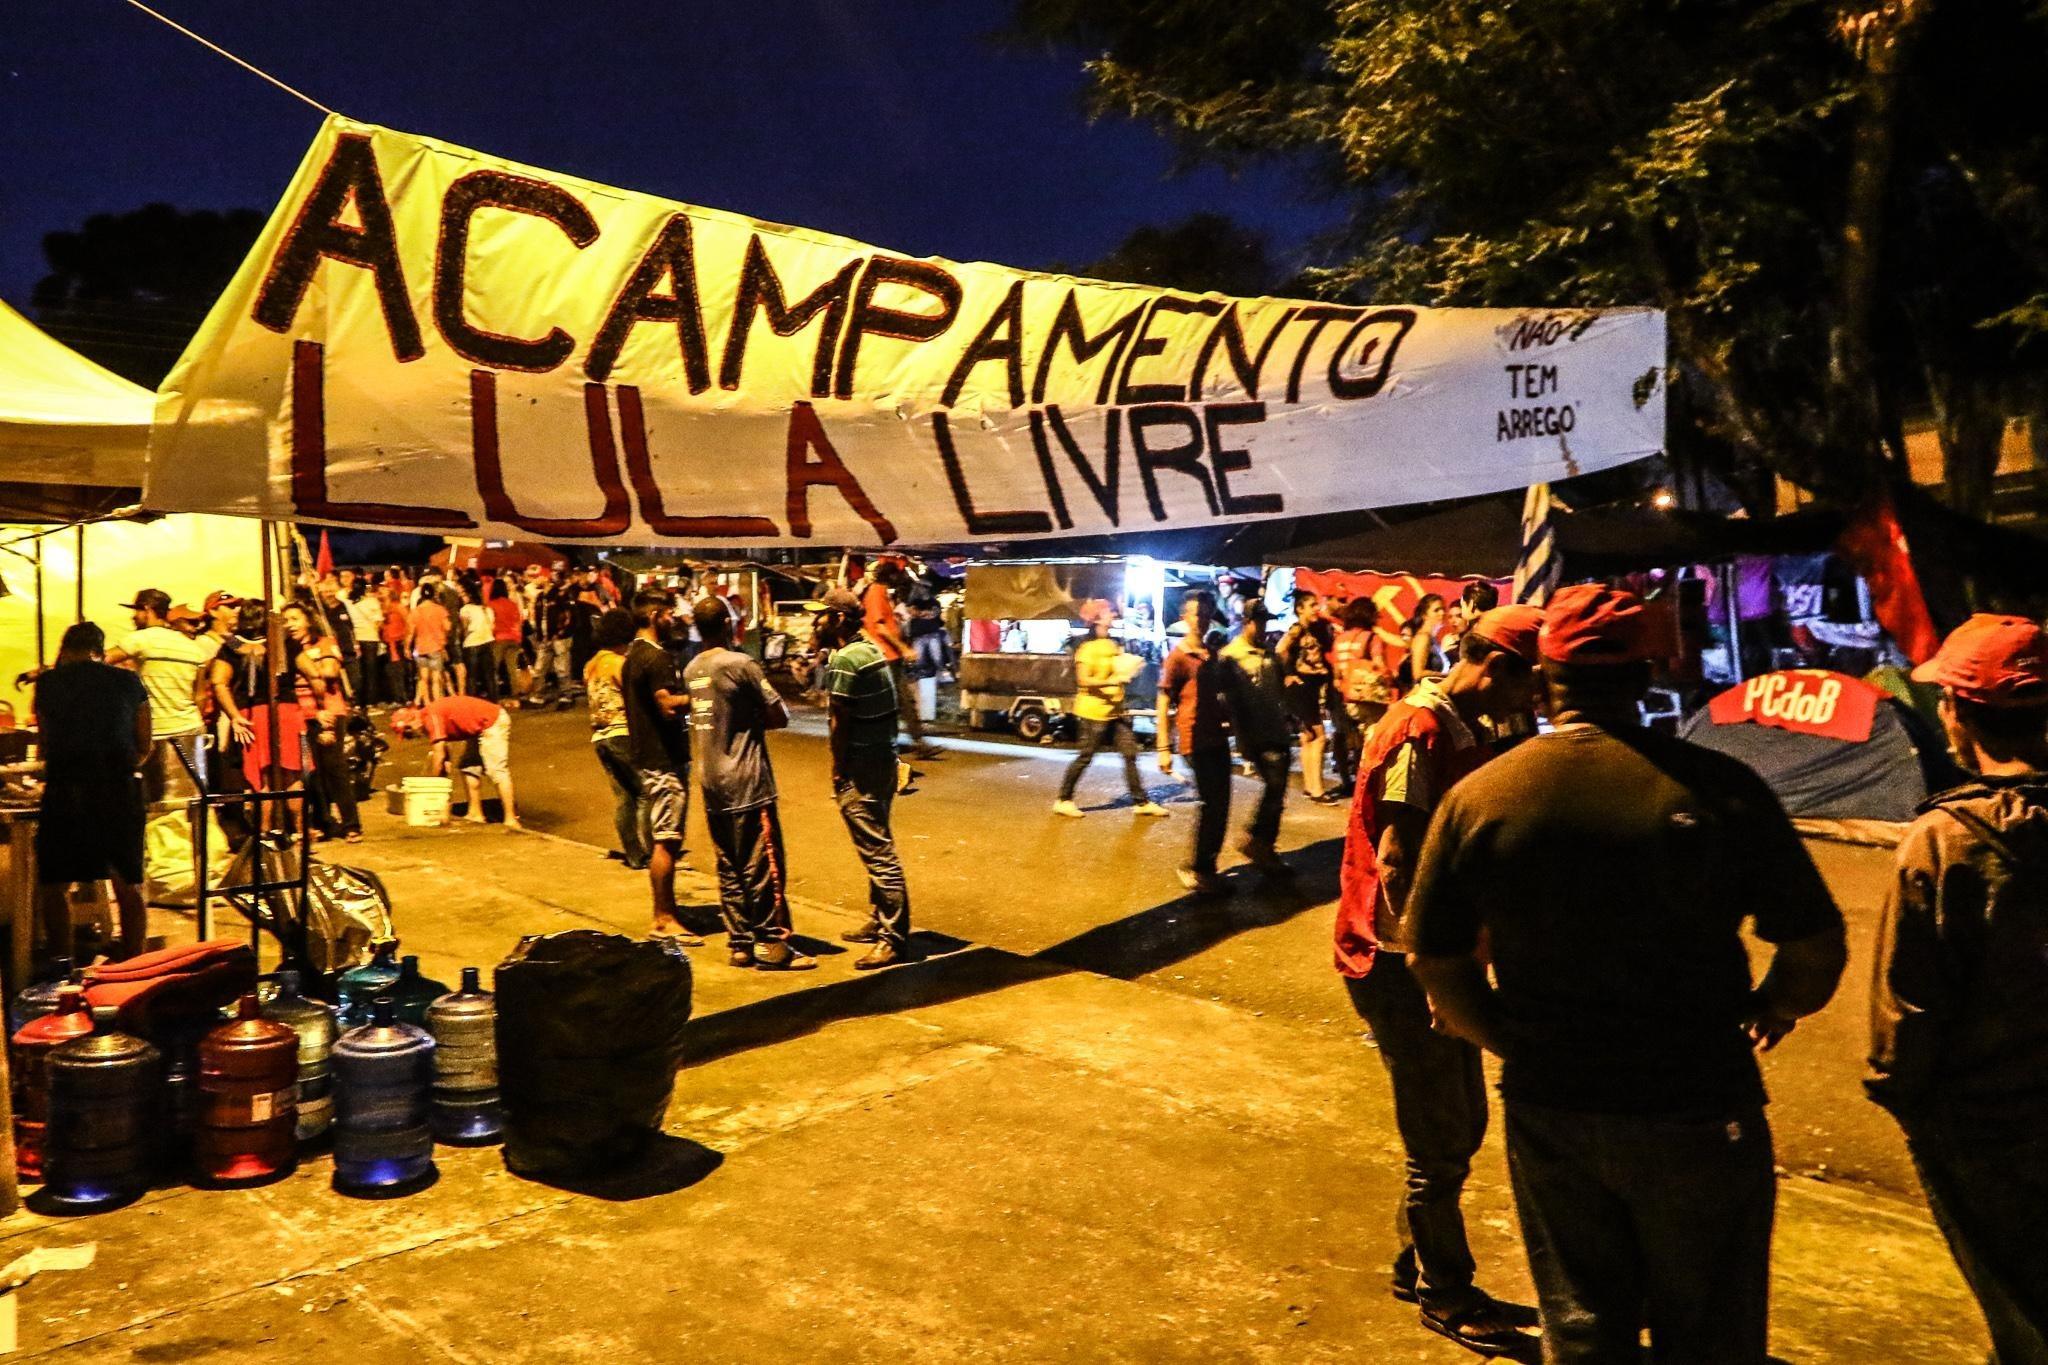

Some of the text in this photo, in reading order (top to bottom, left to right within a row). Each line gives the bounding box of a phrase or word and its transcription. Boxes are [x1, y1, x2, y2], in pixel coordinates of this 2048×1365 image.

[252, 132, 1417, 404] ACAMPAMENTO
[1505, 365, 1558, 399] TEM
[290, 340, 1284, 545] LULA LIVRE
[1496, 404, 1575, 442] ARREGO
[1743, 675, 1842, 724] PCdoB
